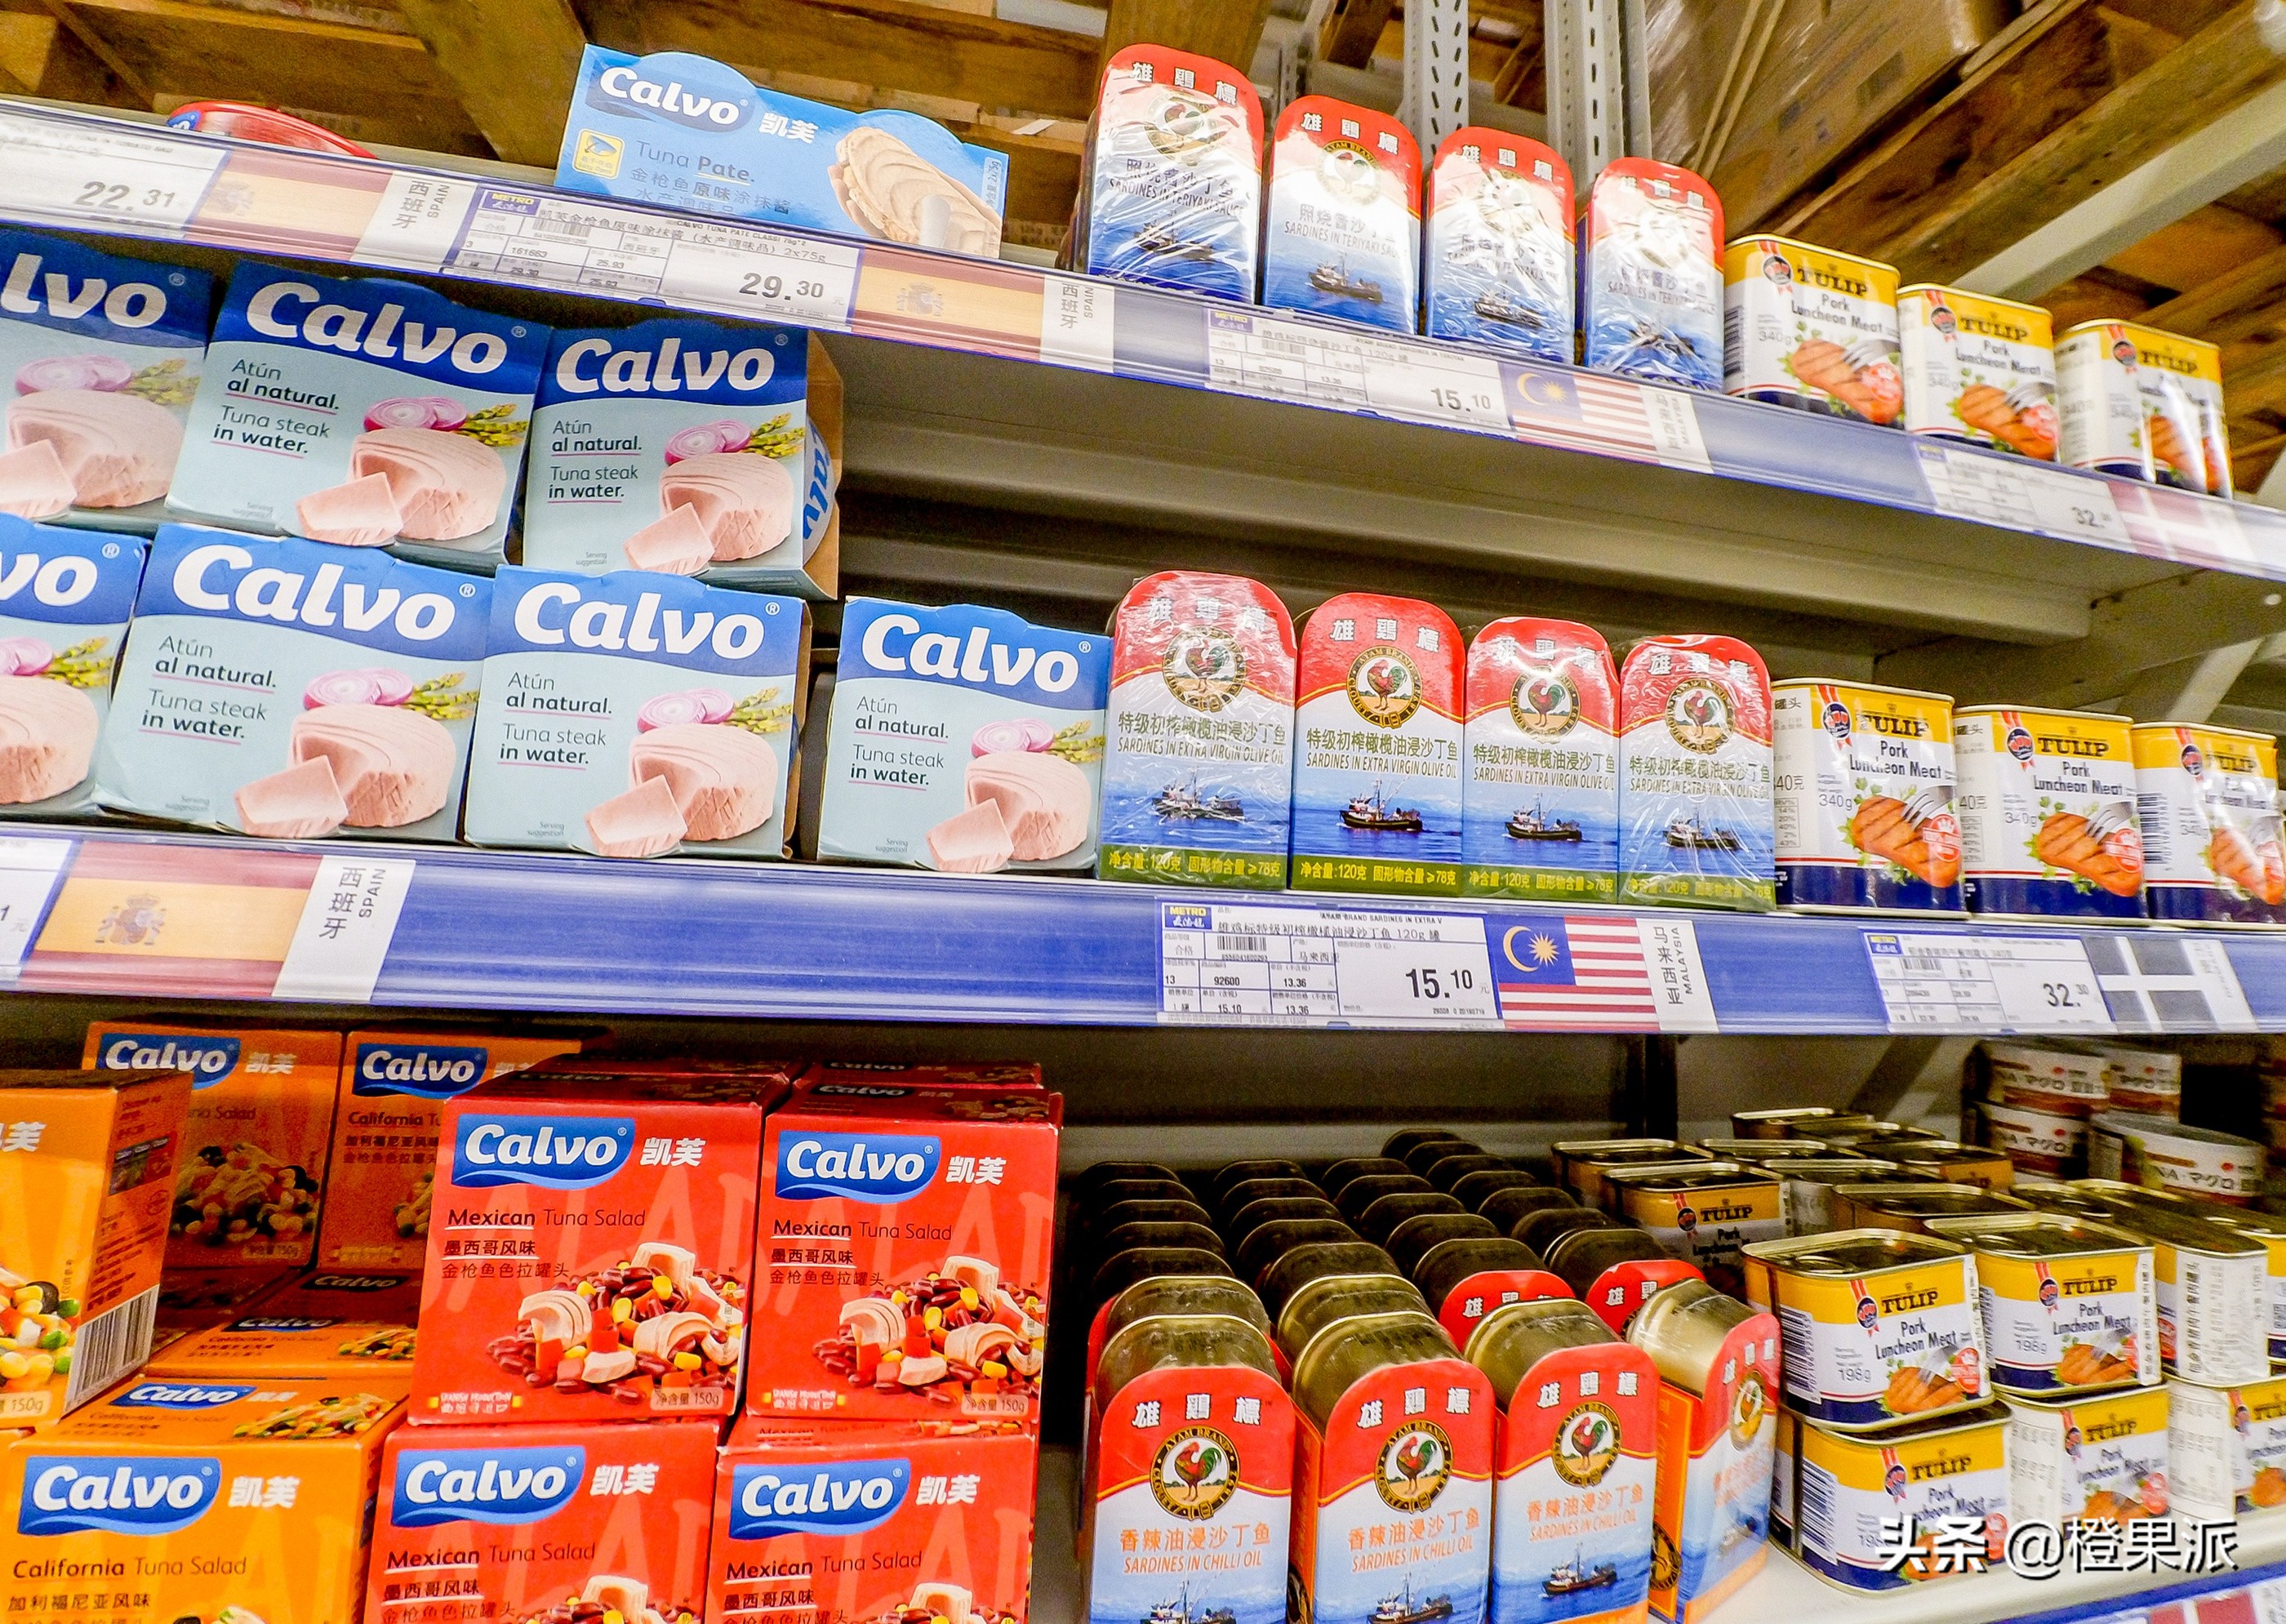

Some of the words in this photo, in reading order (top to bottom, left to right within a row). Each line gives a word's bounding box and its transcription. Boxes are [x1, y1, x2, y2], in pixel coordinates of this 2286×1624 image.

[599, 66, 741, 125] Calvo
[758, 112, 819, 145] 凯芙
[635, 139, 690, 167] Tuna
[697, 155, 755, 185] Pate.
[392, 179, 434, 230] 西班牙
[428, 184, 450, 219] SPAIN
[676, 220, 703, 230] CALVO
[1797, 267, 1869, 296] TULIP
[1061, 281, 1079, 329] 西班牙
[1083, 287, 1094, 318] SPAIN
[247, 282, 508, 374] Calvo
[231, 358, 281, 381] Atún
[556, 337, 775, 394] Calvo
[227, 376, 250, 394] al
[255, 383, 339, 410] natural.
[220, 405, 269, 429] Tuna
[276, 416, 330, 438] steak
[553, 420, 592, 435] Atún
[213, 423, 234, 441] in
[242, 432, 308, 454] water.
[551, 436, 569, 452] al
[573, 434, 642, 452] natural.
[550, 465, 590, 482] Tuna
[595, 464, 638, 480] steak
[549, 484, 565, 499] in
[571, 484, 625, 499] water.
[172, 544, 456, 641] Calvo
[514, 582, 765, 660] Calvo
[158, 635, 213, 658] Atún
[861, 614, 1079, 693] Calvo
[507, 671, 554, 692] Atún
[149, 688, 202, 712] Tuna
[211, 700, 267, 721] steak
[506, 692, 525, 708] al
[532, 695, 612, 714] natural.
[503, 723, 551, 743] Tuna
[557, 727, 607, 746] steak
[855, 715, 872, 730] al
[878, 719, 950, 739] natural.
[499, 743, 518, 759] in
[526, 746, 589, 765] water.
[852, 744, 896, 763] Tuna
[900, 749, 945, 768] steak
[1880, 741, 1909, 759] Pork
[2038, 736, 2110, 757] TULIP
[850, 764, 868, 780] in
[874, 768, 930, 785] water.
[1306, 753, 1349, 769] SARDINES
[1351, 755, 1359, 771] IN
[1363, 756, 1389, 772] EXTRA
[1391, 759, 1420, 774] VIRGIN
[1422, 761, 1444, 776] OLIVE
[1446, 763, 1457, 778] OIL
[2062, 761, 2091, 777] Pork
[2034, 776, 2088, 793] Luncheon
[2092, 780, 2123, 796] Meat
[1818, 794, 1853, 811] 340g
[318, 866, 367, 940] 西班牙
[358, 869, 386, 919] SPAIN
[1170, 906, 1207, 916] METRO
[1369, 914, 1403, 923] SARDINES
[1397, 929, 1425, 941] 120g
[1653, 926, 1683, 1005] 马来西亚
[1671, 926, 1693, 994] MALAYSIA
[1165, 976, 1176, 985] 13
[1214, 977, 1240, 986] 92600
[1283, 978, 1307, 988] 13.36
[1405, 968, 1474, 999] 15.10
[1218, 1003, 1242, 1014] 15.10
[1286, 1005, 1309, 1015] 13.36
[349, 1111, 423, 1126] California
[465, 1123, 618, 1167] Calvo
[640, 1137, 706, 1168] 凯芙
[786, 1140, 926, 1182] Calvo
[945, 1155, 1007, 1186] 凯芙
[447, 1209, 536, 1226] Mexican
[544, 1209, 588, 1226] Tuna
[594, 1209, 646, 1226] Salad
[773, 1219, 852, 1237] Mexican
[858, 1221, 900, 1239] Tuna
[905, 1223, 952, 1241] Salad
[443, 1239, 536, 1256] 墨西哥风味
[771, 1248, 854, 1265] 墨西哥风味
[442, 1263, 570, 1279] 金枪鱼色拉罐头
[770, 1270, 884, 1286] 金枪鱼色拉罐头
[2063, 1279, 2117, 1295] TULIP
[1881, 1290, 1938, 1314] TULIP
[2079, 1303, 2103, 1317] Pork
[1901, 1317, 1927, 1337] Pork
[2053, 1320, 2101, 1335] Luncheon
[2104, 1315, 2130, 1330] Meat
[1875, 1338, 1925, 1360] Luncheon
[1928, 1329, 1957, 1350] Meat
[1838, 1368, 1872, 1383] 198g
[11, 1397, 43, 1413] 150g
[693, 1392, 720, 1407] 150g
[1001, 1399, 1027, 1414] 150g
[33, 1466, 204, 1511] Calvo
[405, 1460, 567, 1504] Calvo
[589, 1463, 660, 1496] 凯芙
[915, 1475, 981, 1506] 凯芙
[228, 1475, 301, 1509] 凯芙
[741, 1474, 894, 1518] Calvo
[387, 1548, 480, 1568] Mexican
[490, 1543, 536, 1562] Tuna
[542, 1542, 596, 1561] Salad
[726, 1560, 813, 1579] Mexican
[821, 1555, 865, 1573] Tuna
[871, 1551, 923, 1570] Salad
[1123, 1555, 1185, 1574] SARDINES
[1187, 1553, 1202, 1571] IN
[1203, 1552, 1241, 1571] CHILLI
[1243, 1551, 1262, 1568] OIL
[1352, 1551, 1408, 1573] SARDINES
[1408, 1547, 1421, 1564] IN
[1423, 1539, 1456, 1561] CHILLI
[1457, 1534, 1474, 1552] OIL
